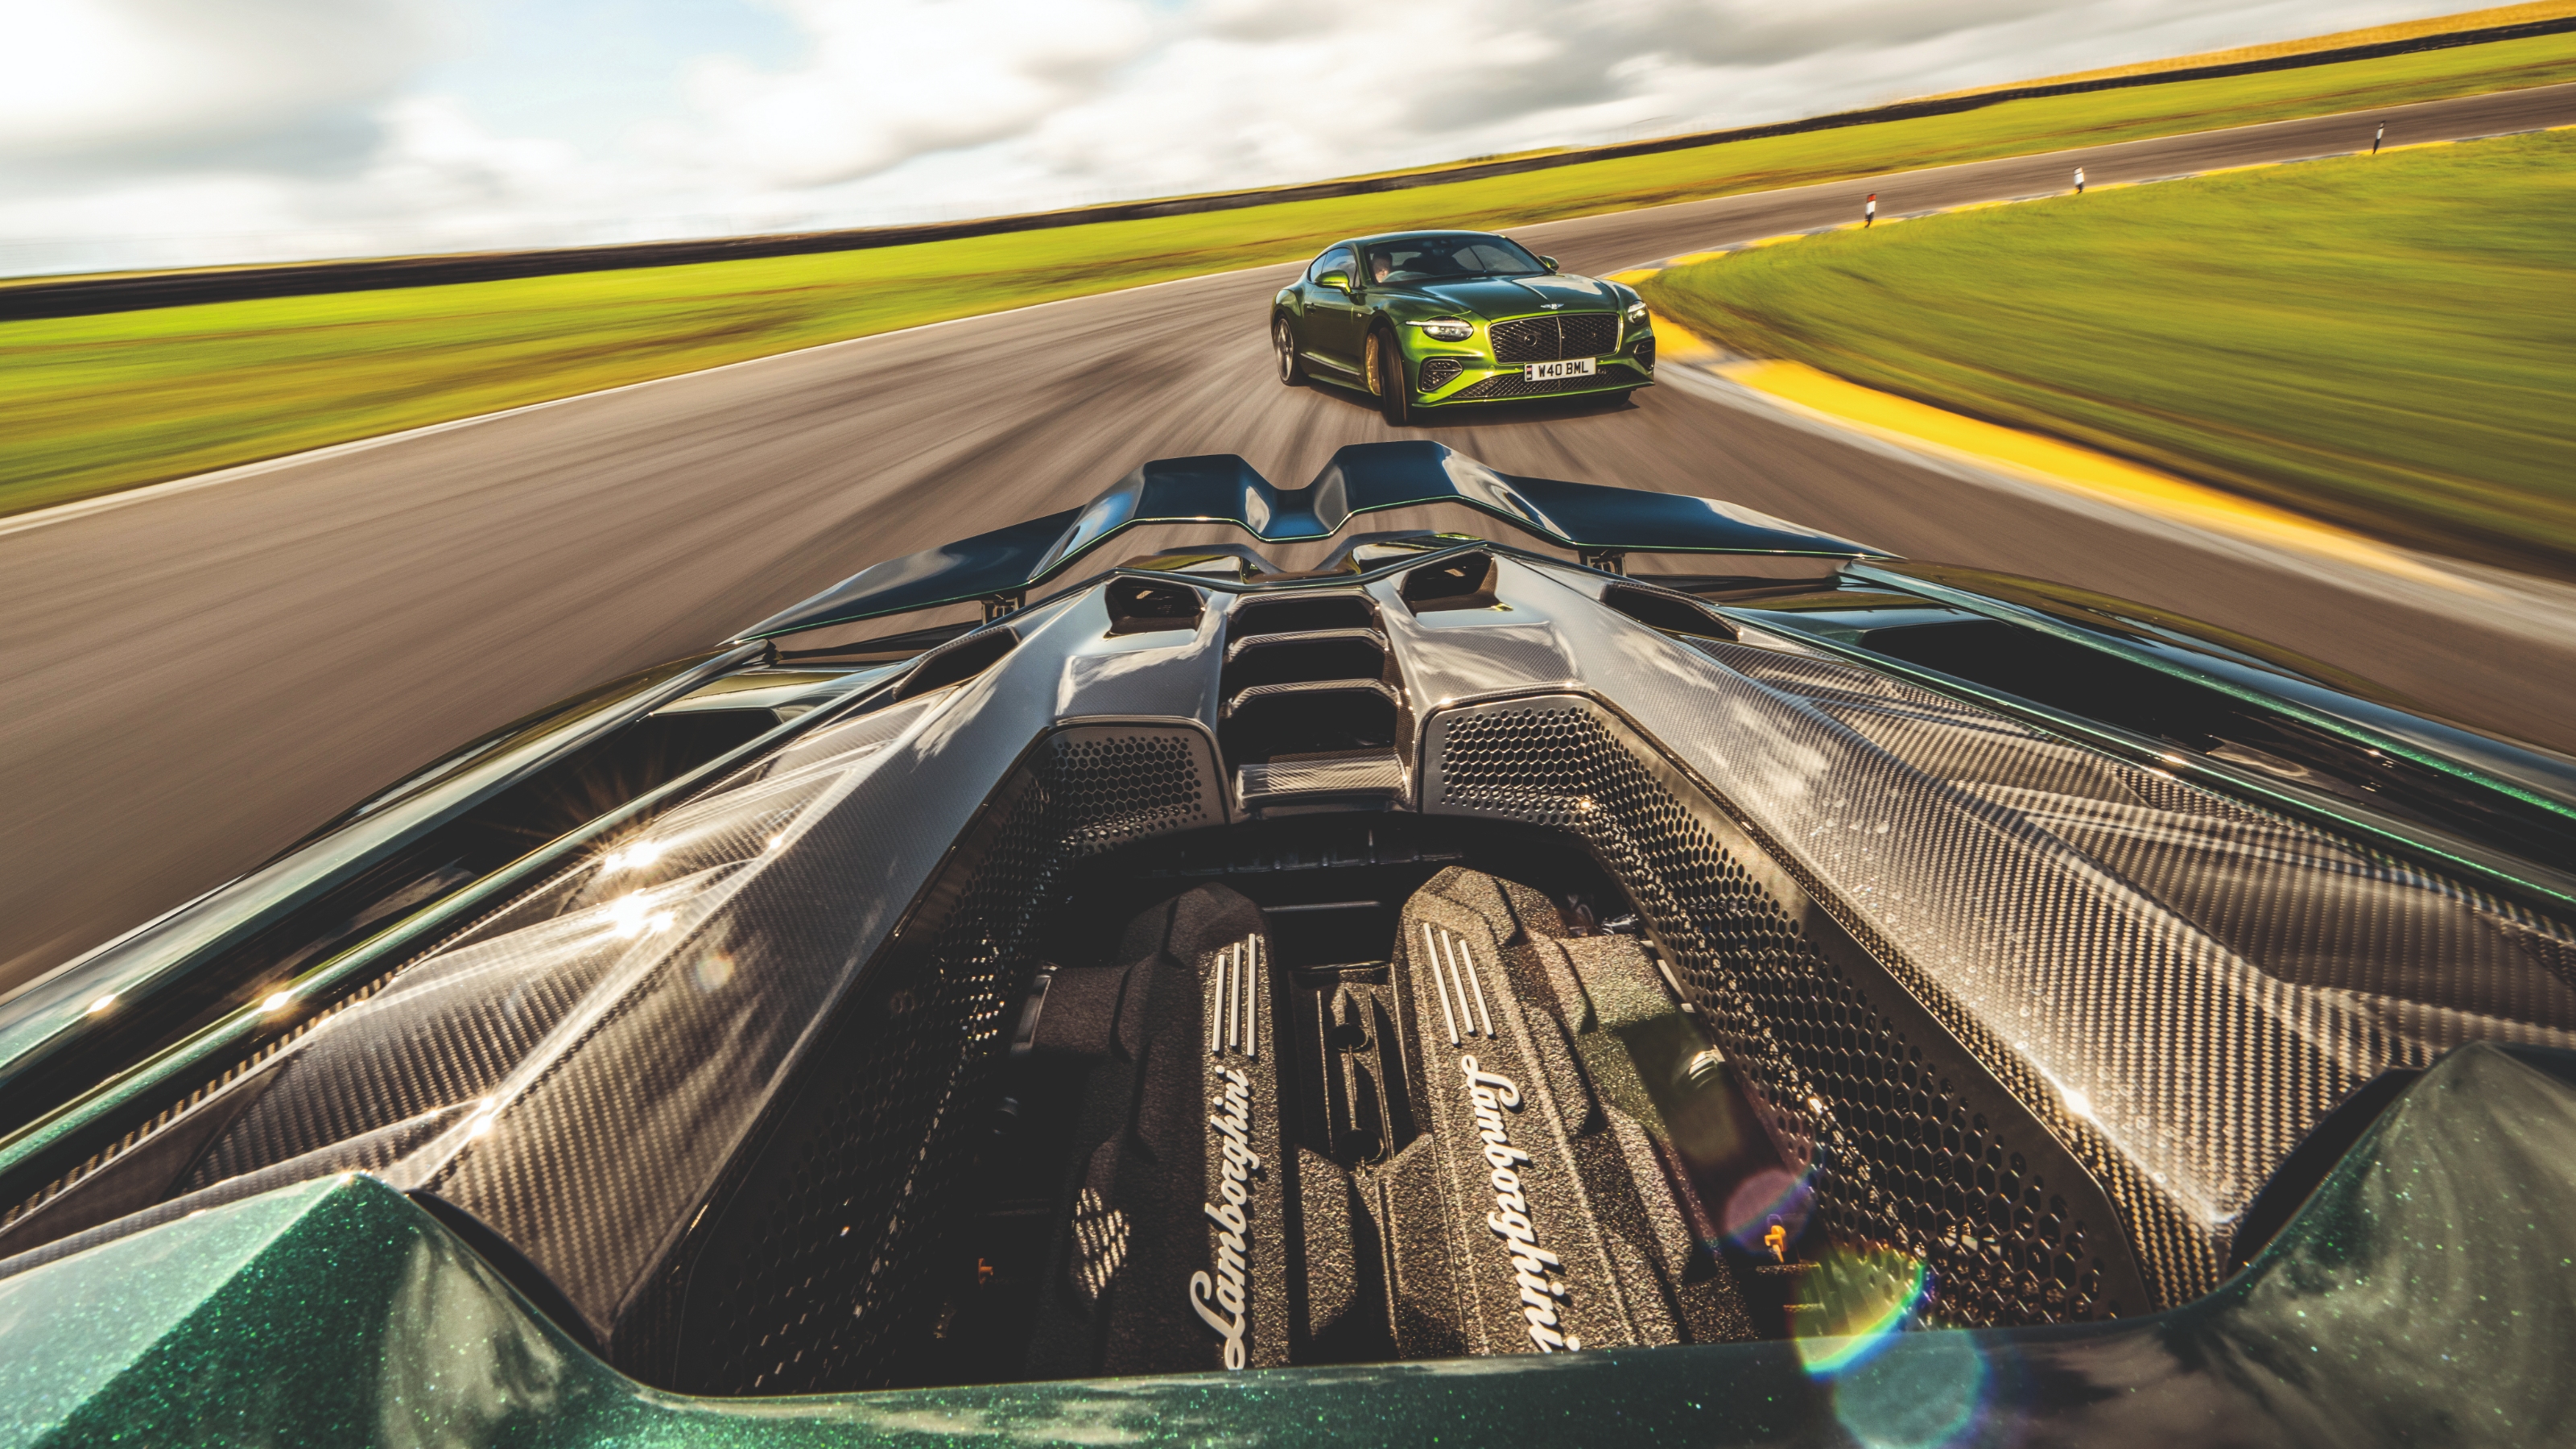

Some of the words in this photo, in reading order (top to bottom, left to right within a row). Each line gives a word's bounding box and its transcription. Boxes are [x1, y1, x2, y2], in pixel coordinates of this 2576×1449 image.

[1538, 364, 1562, 378] W40
[1566, 361, 1588, 375] BML
[1190, 1064, 1260, 1370] Lamborghini
[1461, 1055, 1581, 1353] Lamborghini
